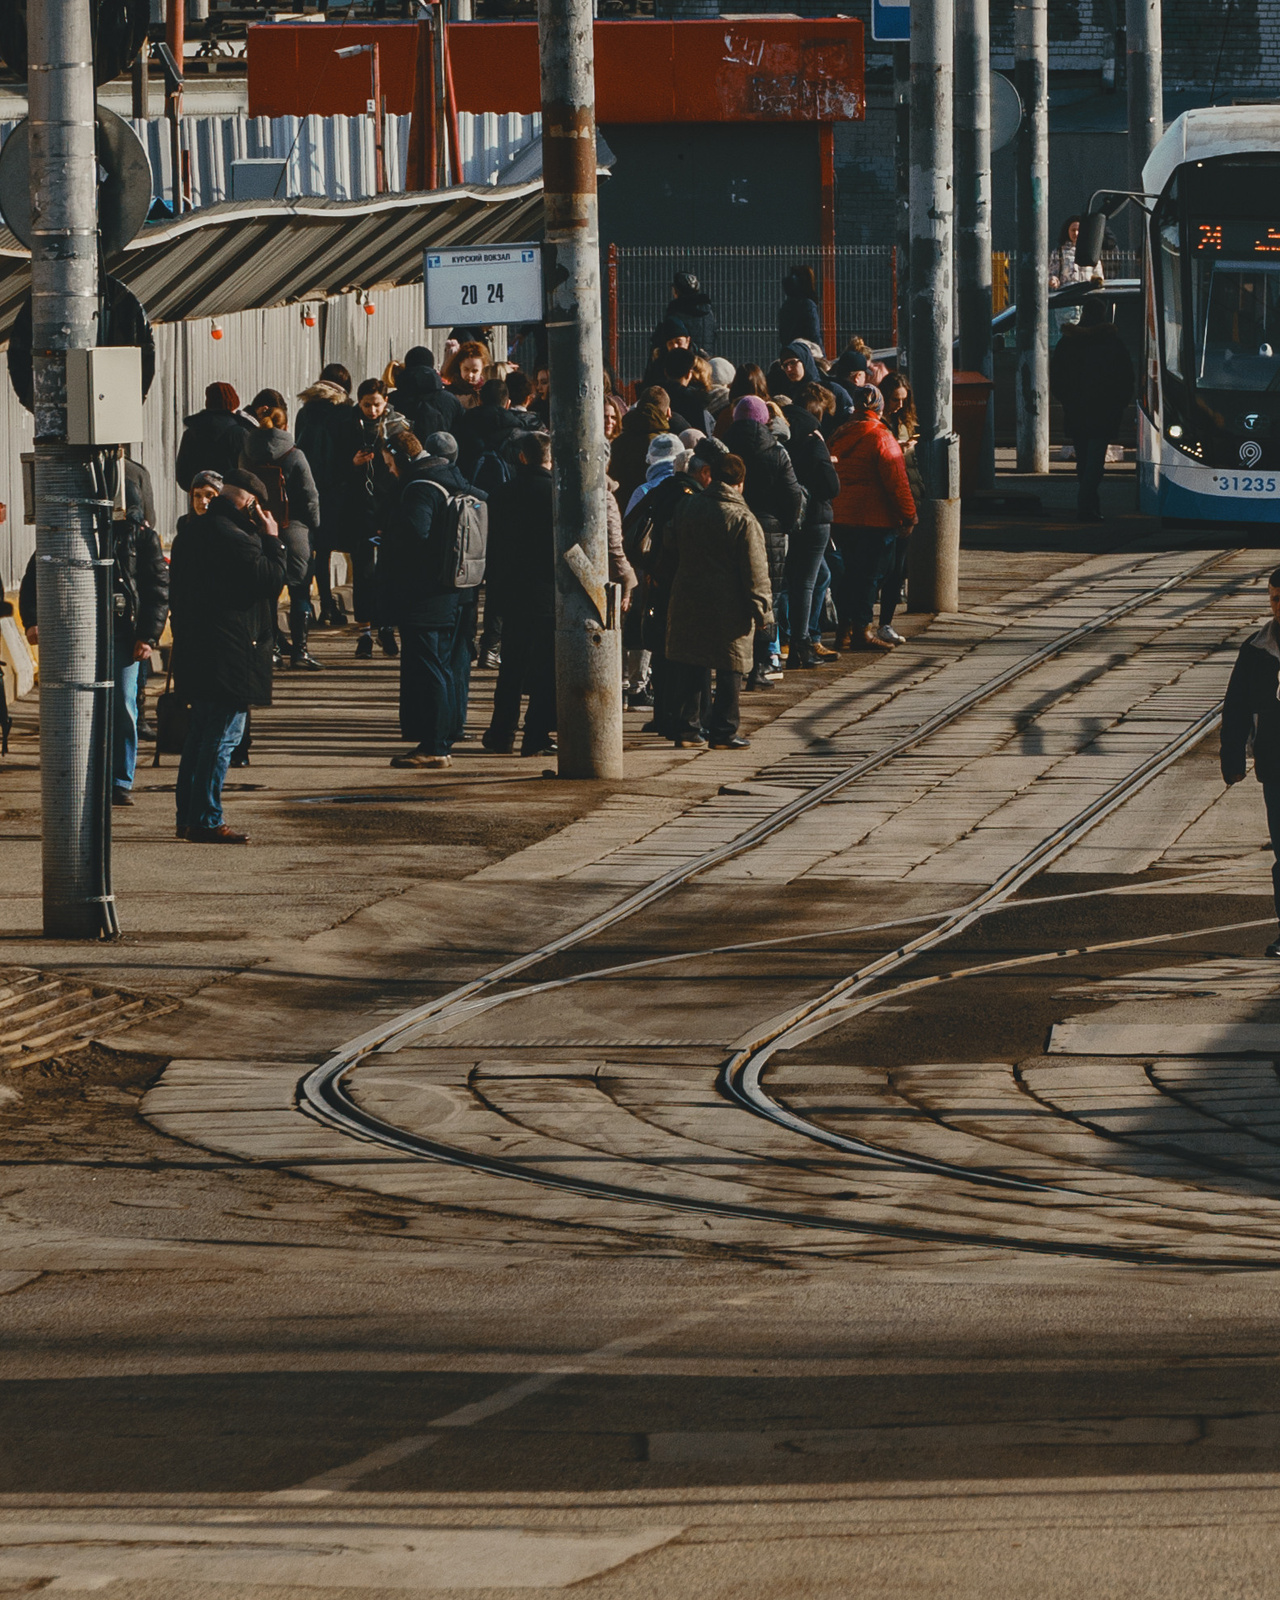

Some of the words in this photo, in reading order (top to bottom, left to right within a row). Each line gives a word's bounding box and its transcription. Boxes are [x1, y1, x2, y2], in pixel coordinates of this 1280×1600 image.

[451, 254, 482, 263] КУРСКИЙ
[483, 253, 511, 262] ВОКЗАЛ
[461, 284, 478, 305] 20
[487, 283, 504, 303] 24
[1219, 476, 1276, 492] 31235
